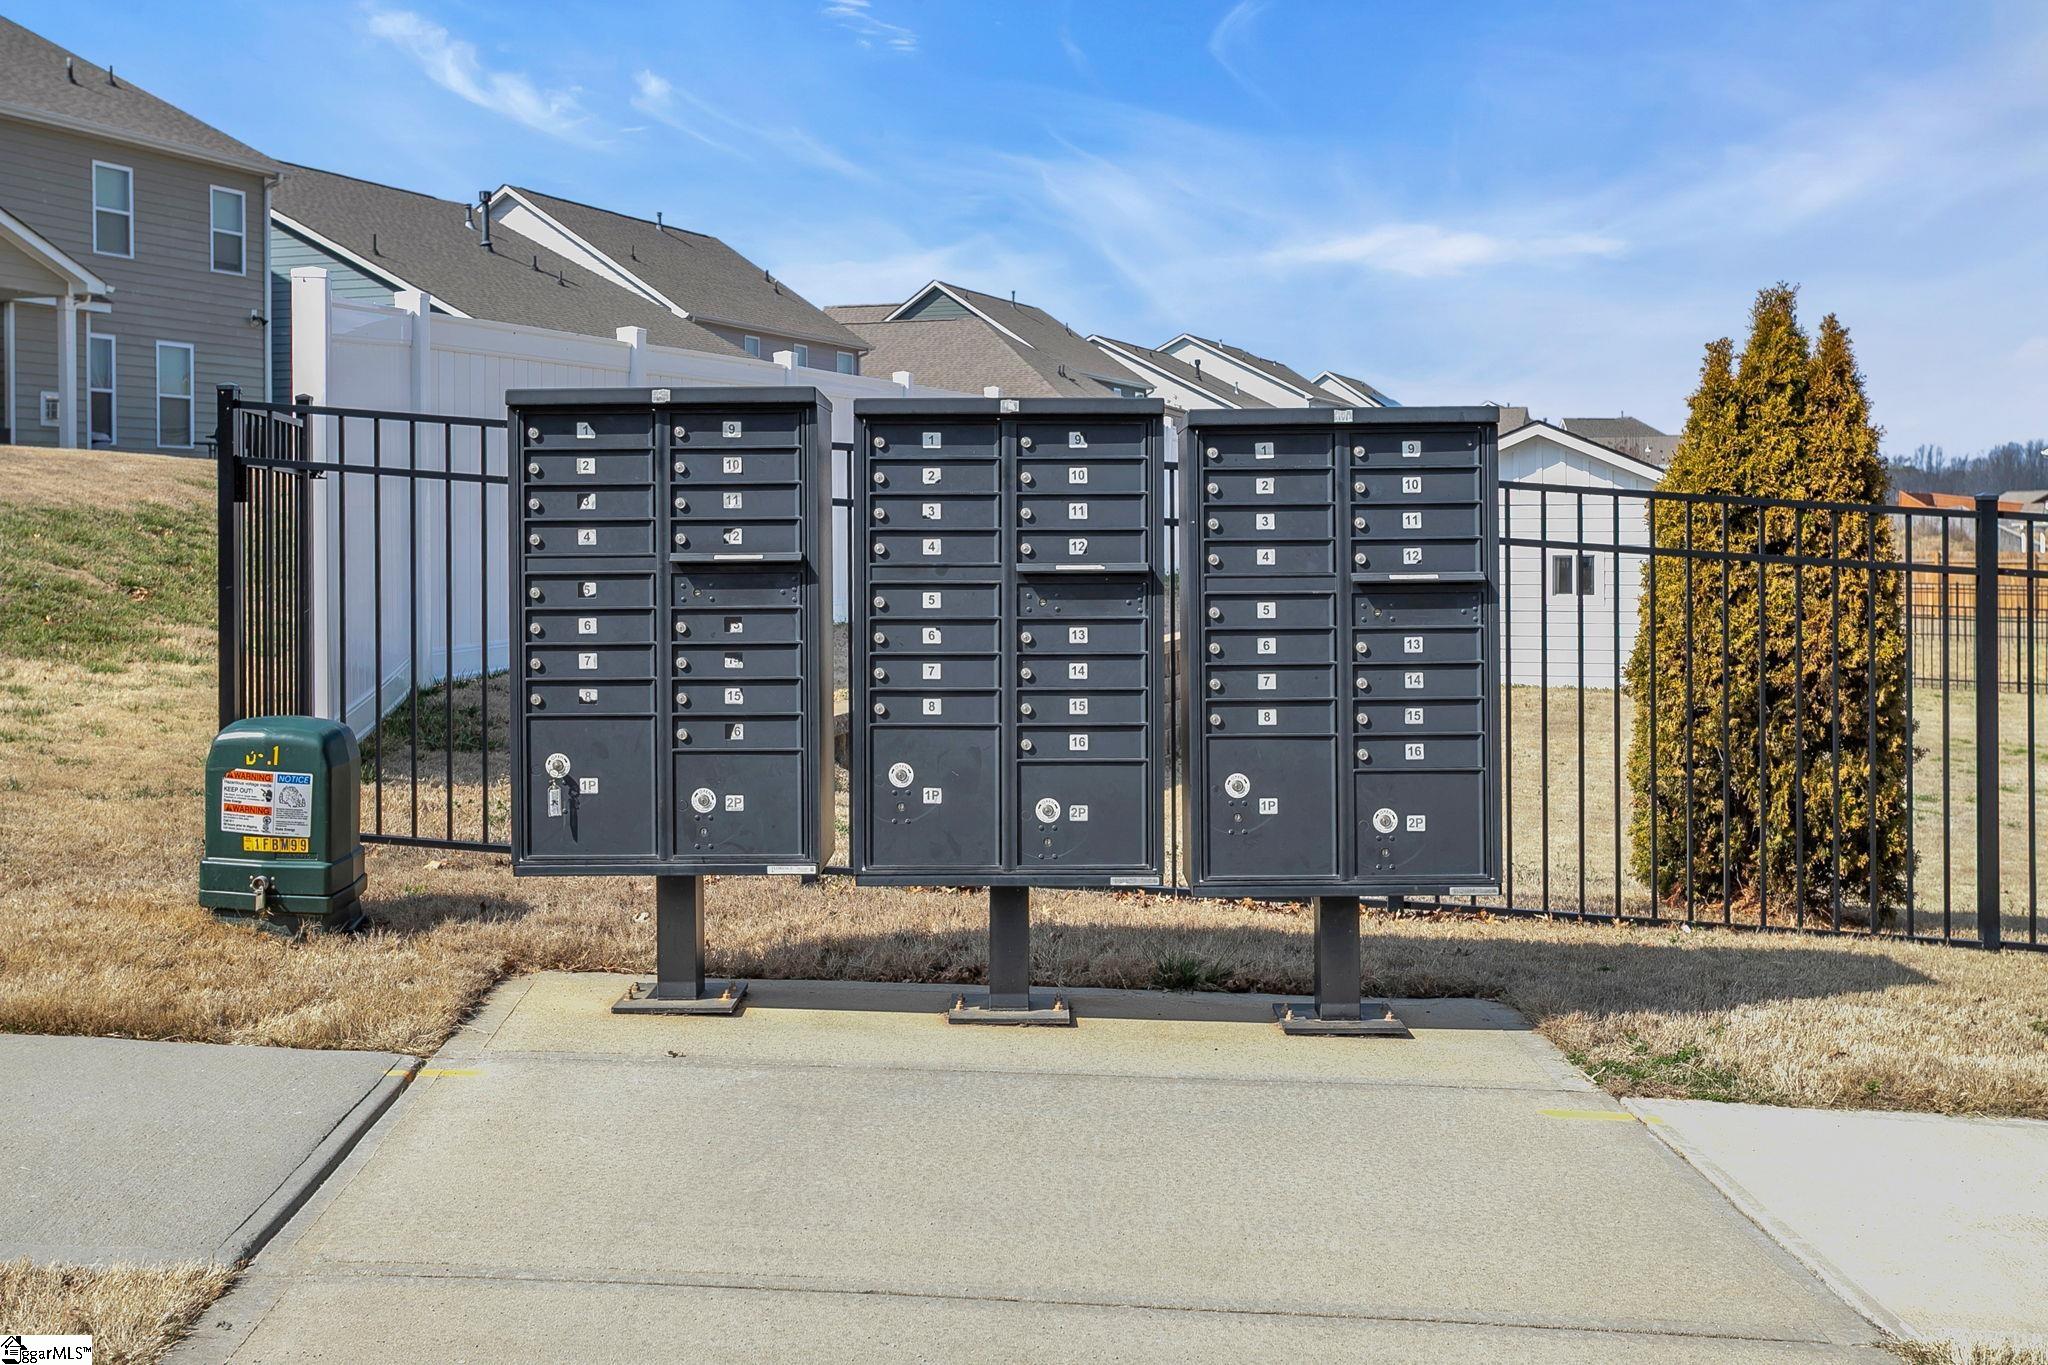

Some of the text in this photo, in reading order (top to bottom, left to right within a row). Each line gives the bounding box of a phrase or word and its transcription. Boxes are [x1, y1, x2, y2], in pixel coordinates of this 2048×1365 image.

[582, 425, 588, 435] 1
[728, 423, 736, 434] 9
[928, 434, 934, 446] 1
[1074, 434, 1082, 445] 9
[1260, 444, 1267, 456] 1
[1407, 443, 1415, 454] 9
[582, 460, 589, 471] 2
[726, 459, 740, 471] 10
[928, 470, 935, 481] 2
[1071, 470, 1085, 481] 10
[1261, 480, 1269, 491] 2
[1405, 479, 1419, 490] 10
[582, 496, 590, 507] 3
[726, 494, 738, 505] 11
[928, 506, 935, 516] 3
[1071, 505, 1084, 516] 11
[1262, 516, 1269, 527] 3
[1405, 515, 1418, 525] 11
[583, 531, 591, 543] 4
[928, 541, 936, 552] 4
[1071, 541, 1085, 551] 12
[1262, 551, 1270, 562] 4
[1405, 550, 1420, 561] 12
[583, 584, 591, 596] 5
[928, 594, 935, 605] 5
[1263, 605, 1270, 615] 5
[584, 620, 591, 631] 6
[928, 630, 935, 641] 6
[1072, 629, 1086, 640] 13
[1263, 640, 1270, 651] 6
[1406, 639, 1421, 650] 13
[584, 655, 591, 666] 7
[928, 666, 935, 676] 7
[1071, 665, 1085, 676] 14
[1263, 676, 1270, 687] 7
[1407, 674, 1421, 685] 14
[584, 691, 592, 702] 8
[727, 690, 742, 702] 15
[928, 701, 936, 712] 8
[1071, 700, 1086, 711] 15
[1263, 711, 1271, 722] 8
[1407, 710, 1421, 721] 15
[1072, 736, 1086, 747] 16
[1408, 746, 1422, 757] 16
[279, 775, 309, 784] NOTICE
[581, 780, 596, 791] 1P
[925, 790, 940, 800] 1P
[726, 797, 742, 809] 2P
[1261, 800, 1276, 811] 1P
[1071, 807, 1086, 818] 2P
[1408, 817, 1424, 828] 2P
